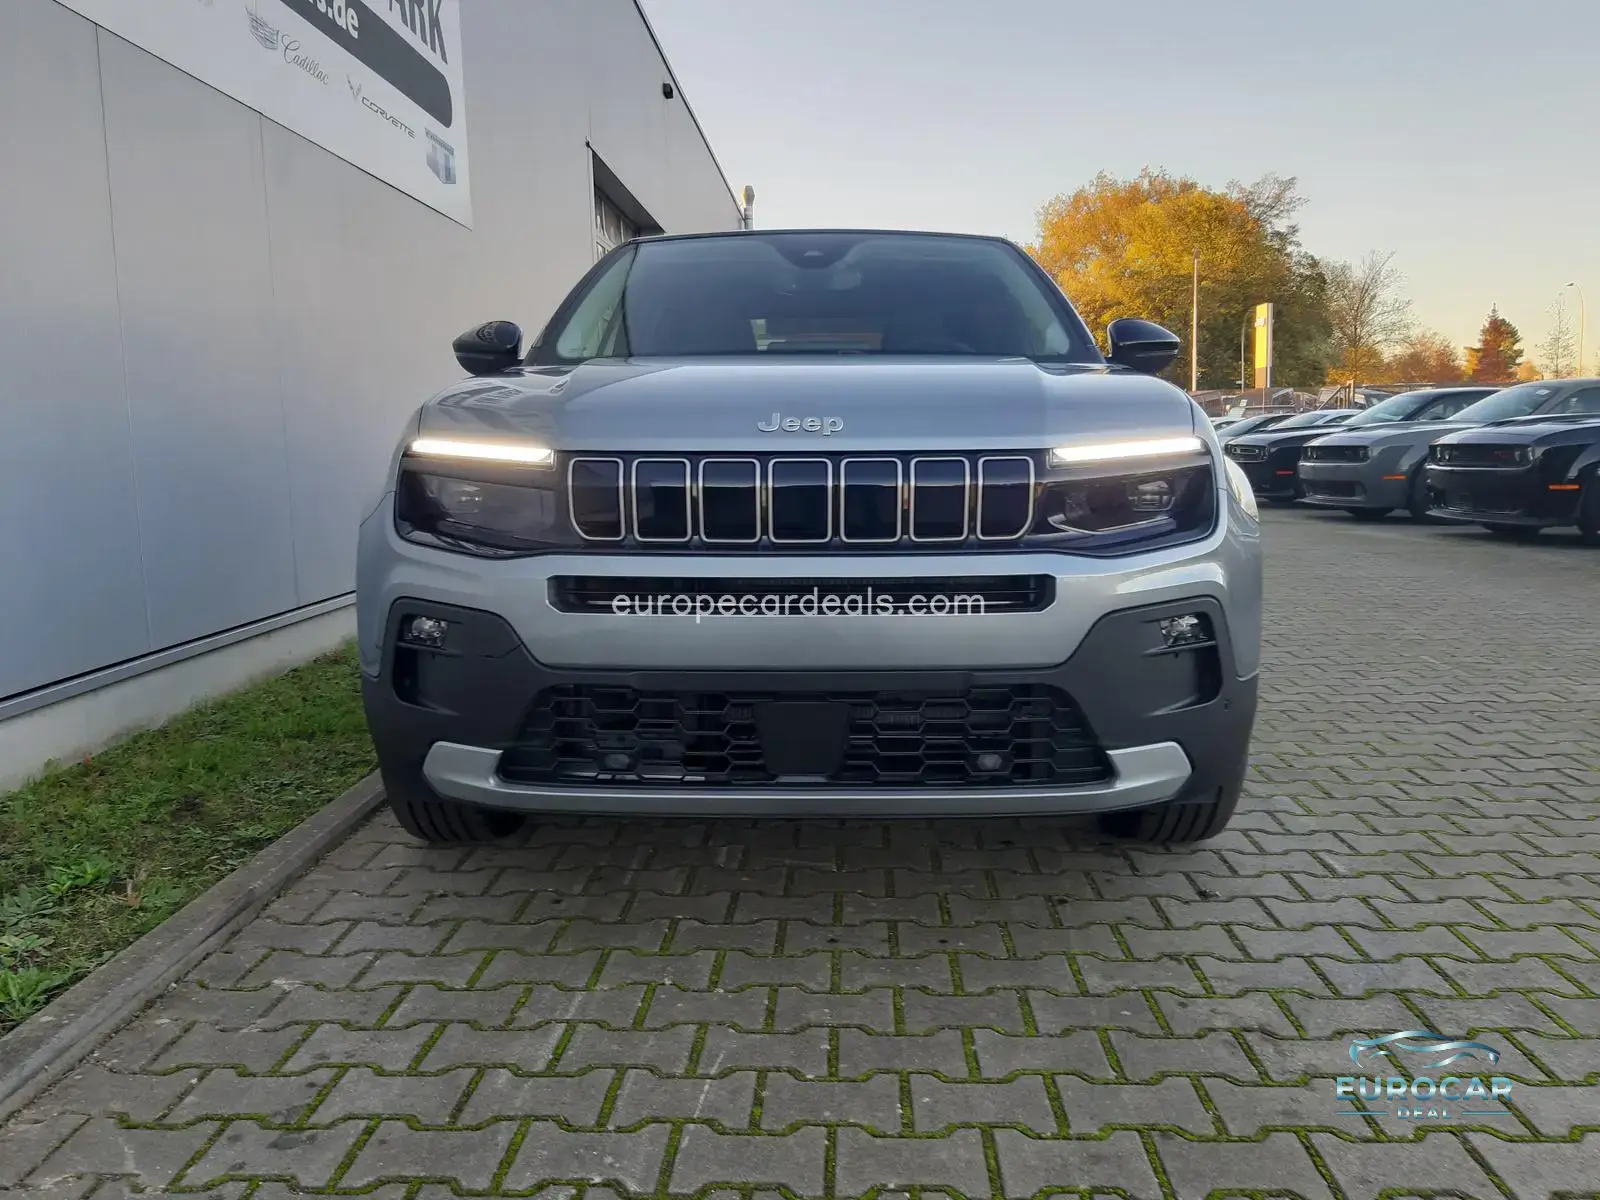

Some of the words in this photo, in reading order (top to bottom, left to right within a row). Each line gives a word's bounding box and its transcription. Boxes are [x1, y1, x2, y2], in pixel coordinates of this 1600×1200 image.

[281, 34, 329, 86] Cadillac
[361, 96, 416, 139] CORVETTE
[757, 412, 844, 436] Jeep
